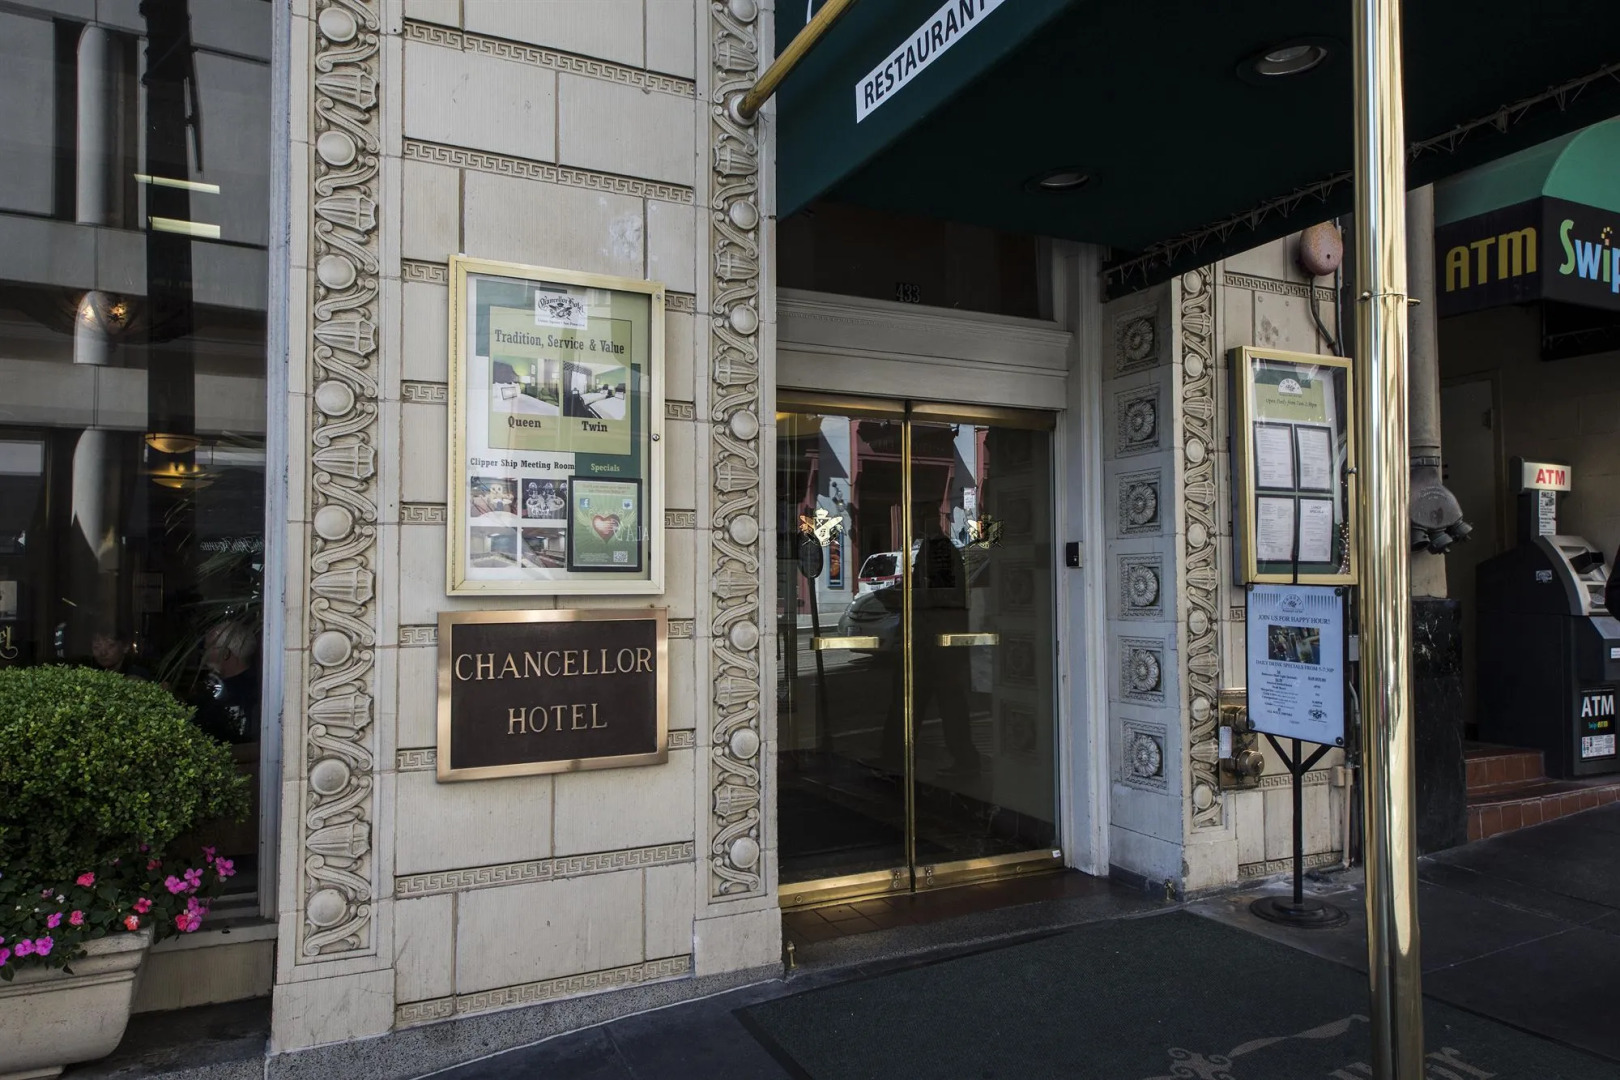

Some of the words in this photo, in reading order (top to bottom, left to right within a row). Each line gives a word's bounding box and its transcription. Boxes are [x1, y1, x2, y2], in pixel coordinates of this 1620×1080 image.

[1446, 227, 1537, 292] ATM
[495, 329, 544, 349] Tradition,
[548, 334, 584, 350] Service
[589, 338, 597, 351] &
[600, 340, 625, 355] Value
[507, 415, 542, 429] Queen
[581, 420, 608, 433] Twin
[470, 457, 498, 468] Clipper
[501, 459, 518, 470] Ship
[520, 460, 551, 470] Meeting
[554, 461, 575, 470] Room
[590, 463, 620, 473] Specials
[1535, 468, 1566, 486] ATM
[1291, 616, 1310, 624] HAPPY
[455, 647, 653, 681] CHANCELLOR
[1581, 695, 1615, 717] ATM
[507, 703, 608, 735] HOTEL
